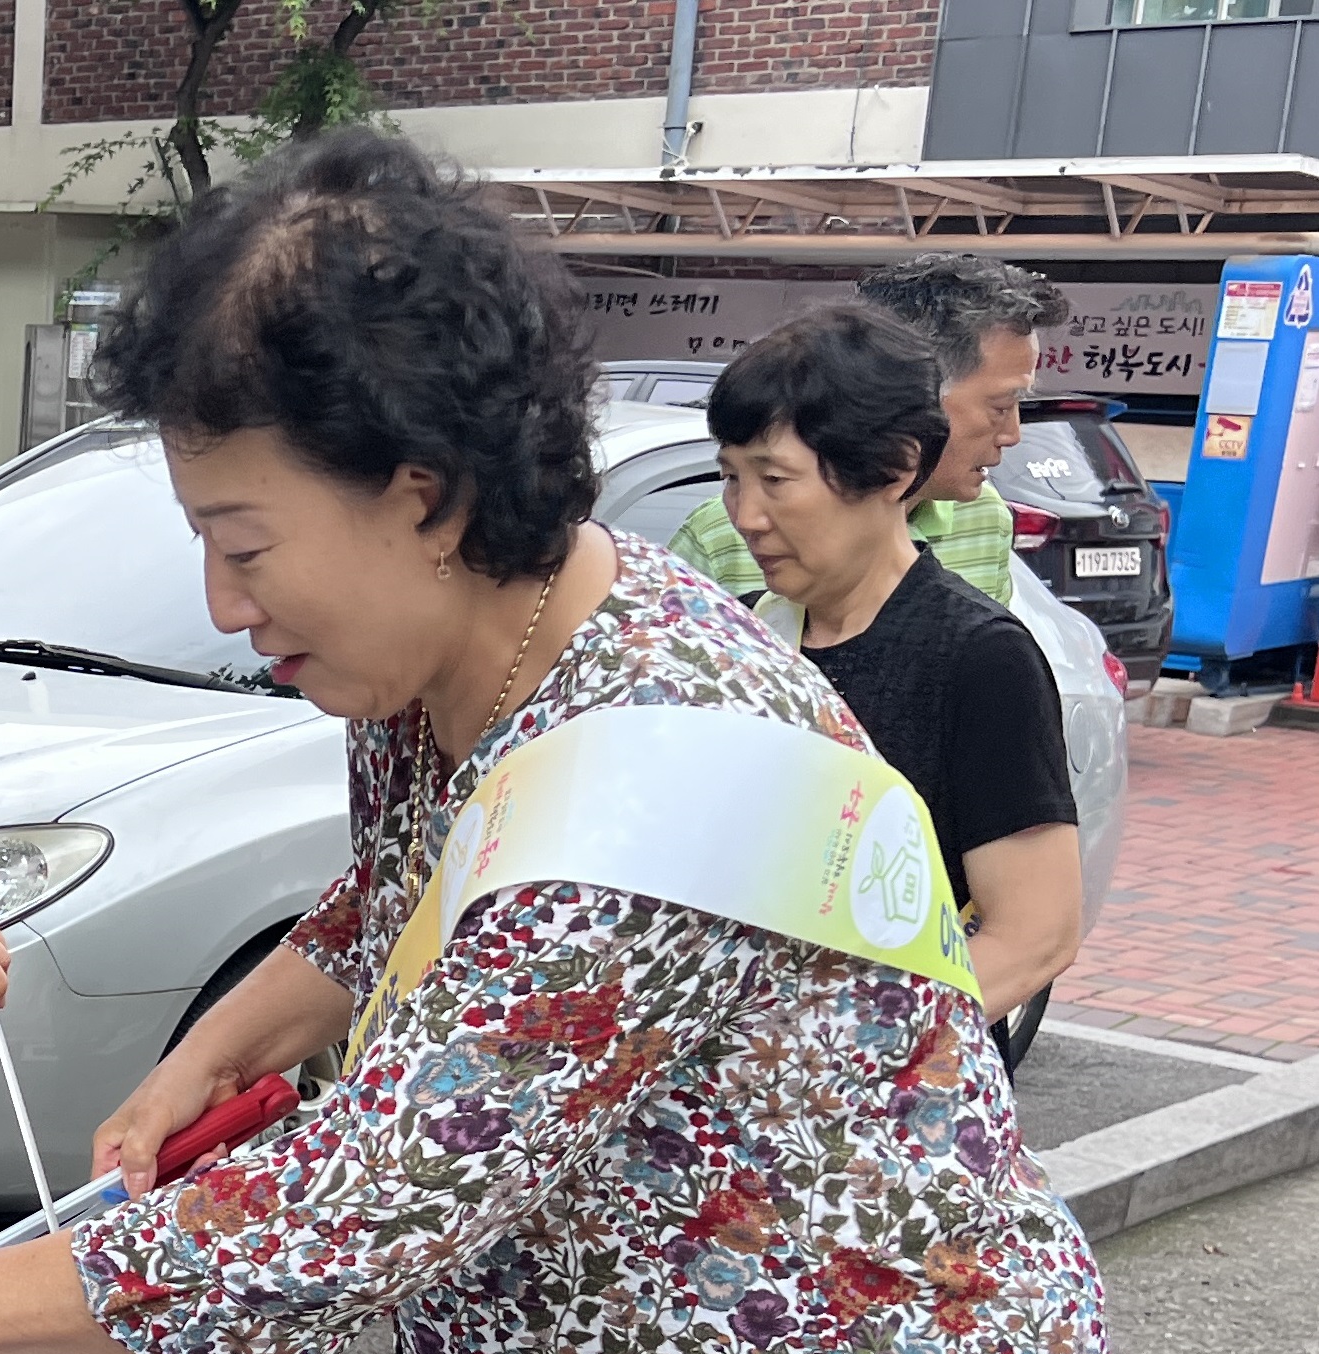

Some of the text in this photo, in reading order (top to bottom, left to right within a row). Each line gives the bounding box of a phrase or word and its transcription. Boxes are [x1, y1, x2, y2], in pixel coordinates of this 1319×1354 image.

[649, 294, 720, 315] 쓰레기
[1069, 315, 1205, 337] 살고 싶은 도시!
[1083, 344, 1192, 382] 행복도시
[1219, 440, 1244, 450] CCTV
